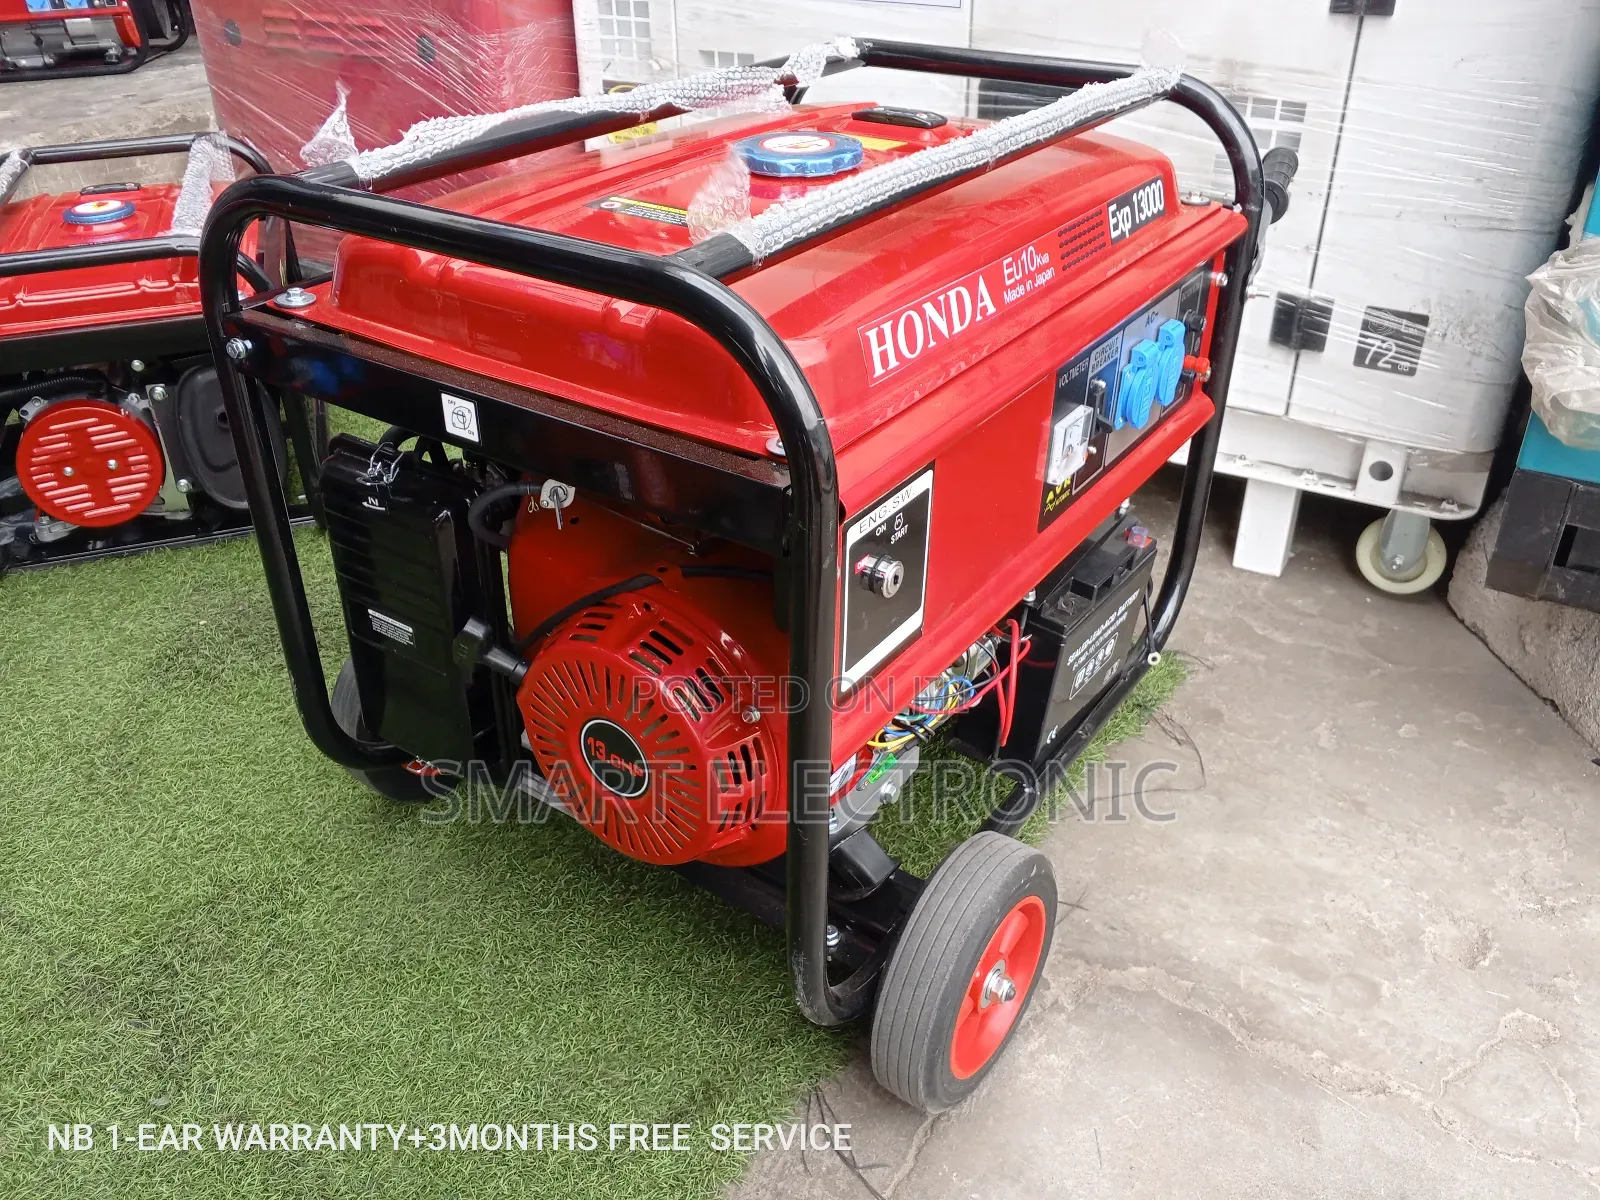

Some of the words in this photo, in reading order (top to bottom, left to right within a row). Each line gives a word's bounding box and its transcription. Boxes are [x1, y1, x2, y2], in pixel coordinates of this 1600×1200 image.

[1108, 201, 1132, 239] Exp
[1132, 179, 1165, 224] 13000
[1003, 283, 1025, 305] Made
[1026, 277, 1033, 291] in
[1034, 266, 1056, 288] Japan
[865, 274, 996, 378] HONDA
[1091, 346, 1119, 373] BREAKER
[1094, 336, 1119, 361] CIRCUIT
[1364, 337, 1396, 369] 72
[1058, 357, 1089, 389] VOLTMETER
[875, 522, 887, 536] ON
[890, 524, 909, 545] START
